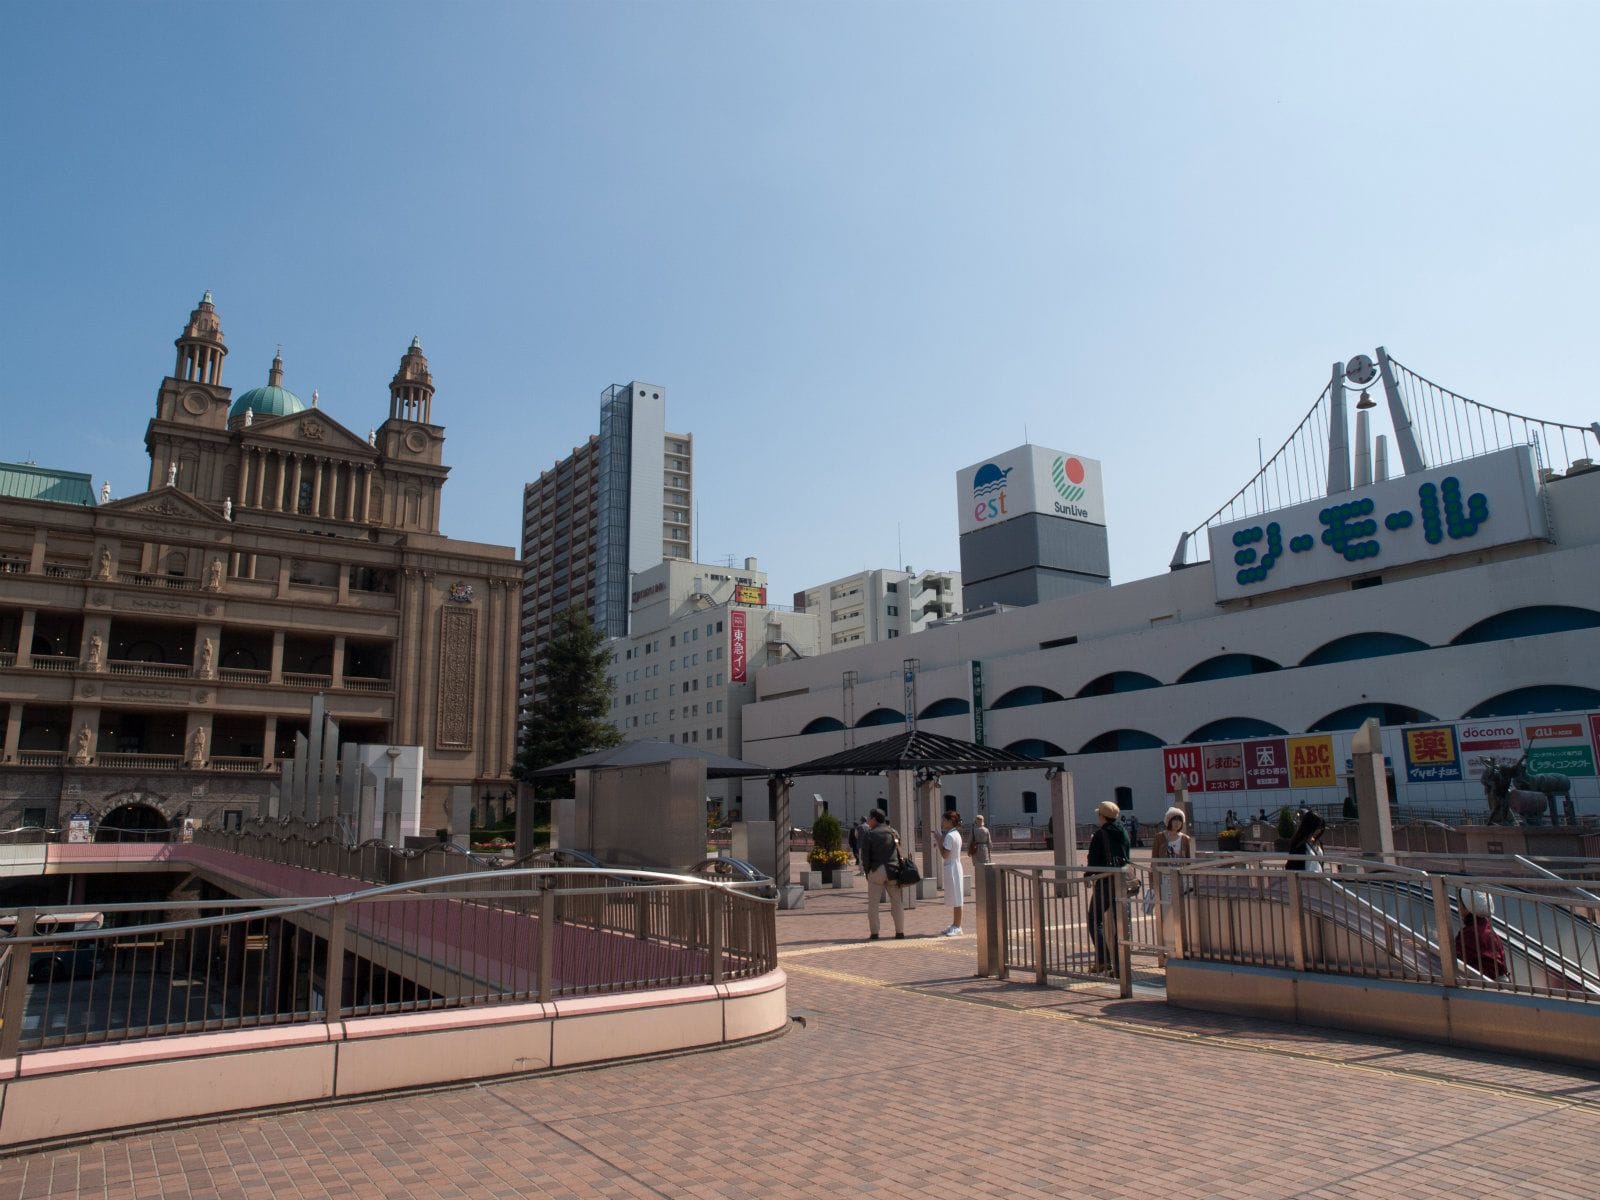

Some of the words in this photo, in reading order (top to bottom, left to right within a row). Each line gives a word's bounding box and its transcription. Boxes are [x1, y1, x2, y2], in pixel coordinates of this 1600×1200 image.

[974, 490, 1008, 522] est
[1054, 501, 1088, 518] SunLive
[1233, 476, 1489, 585] シーモール
[733, 629, 745, 679] 東急イン
[1463, 727, 1514, 738] docomo
[1535, 727, 1552, 737] au
[1168, 752, 1196, 769] UNI
[1206, 755, 1241, 769] しまむら
[1294, 744, 1330, 765] ABC
[1294, 765, 1331, 779] MART
[1211, 781, 1229, 789] エスト
[1229, 780, 1240, 789] 3F
